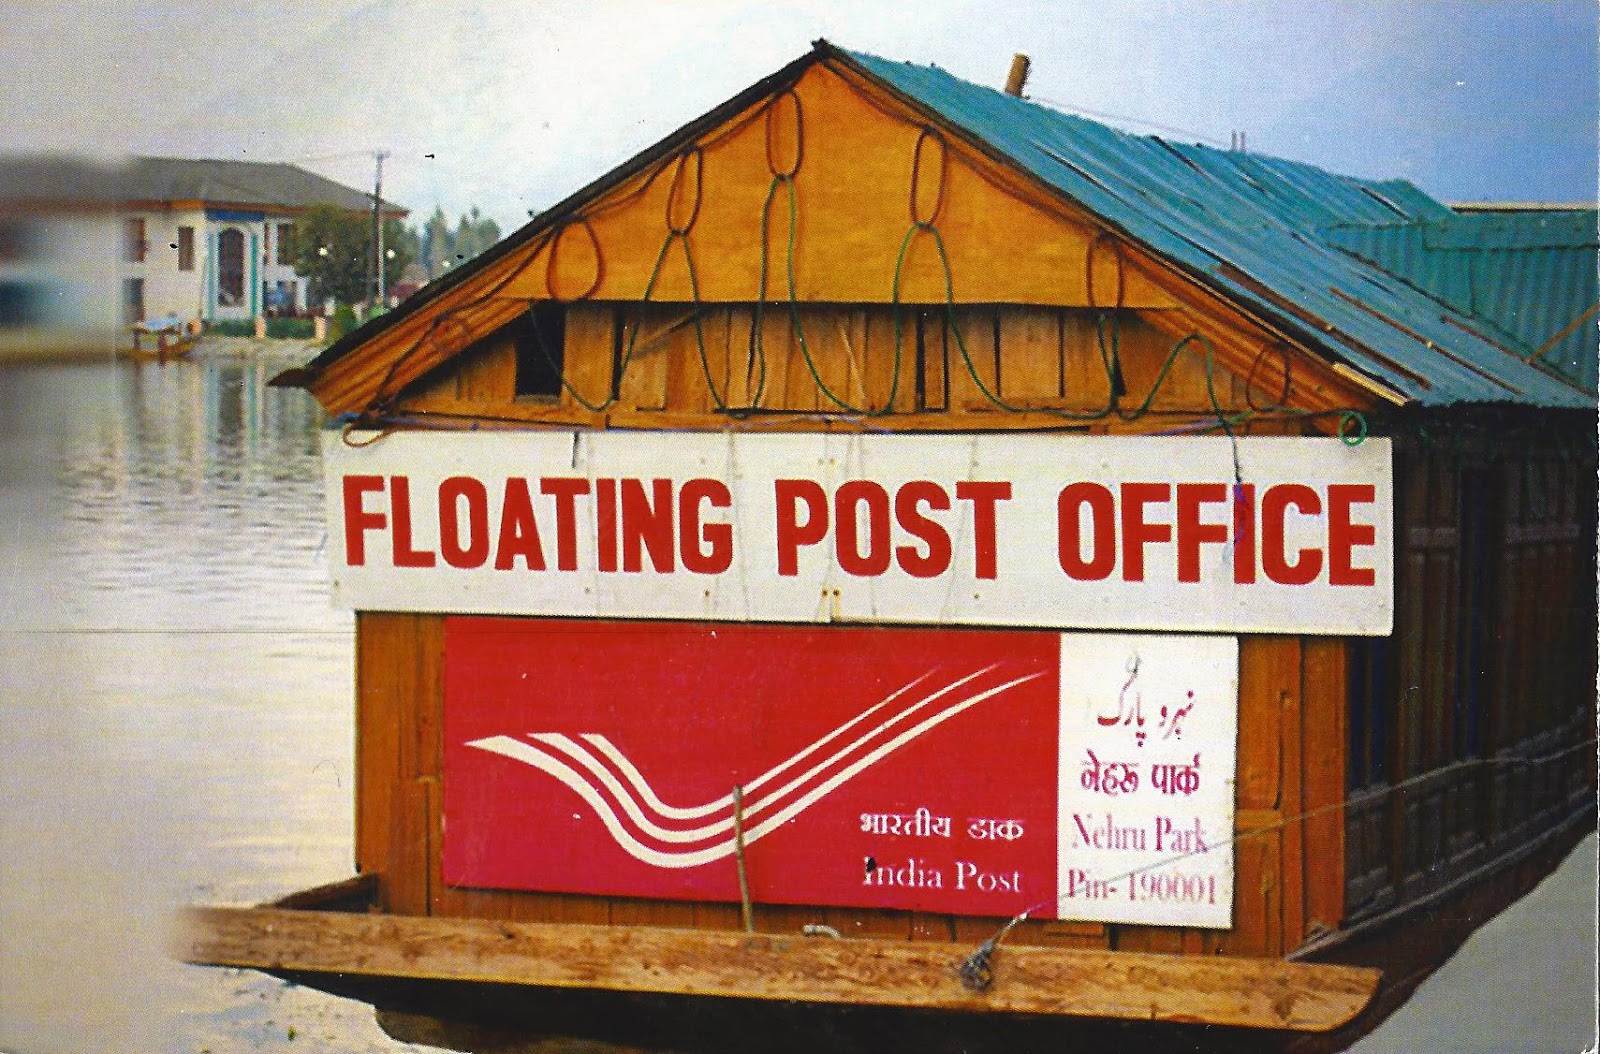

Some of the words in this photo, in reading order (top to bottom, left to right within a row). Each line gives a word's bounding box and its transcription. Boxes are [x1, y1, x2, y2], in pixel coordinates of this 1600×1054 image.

[343, 474, 733, 576] FLOATING
[775, 478, 1012, 581] POST
[1057, 482, 1377, 588] OFFICE
[1151, 752, 1201, 796] पार्क
[859, 806, 952, 838] भारतीय
[966, 815, 1026, 841] डाक
[1071, 813, 1146, 852] Nehru
[1154, 815, 1210, 854] Park
[862, 856, 944, 889] India
[954, 861, 1022, 893] Post
[1128, 872, 1217, 905] 190001
